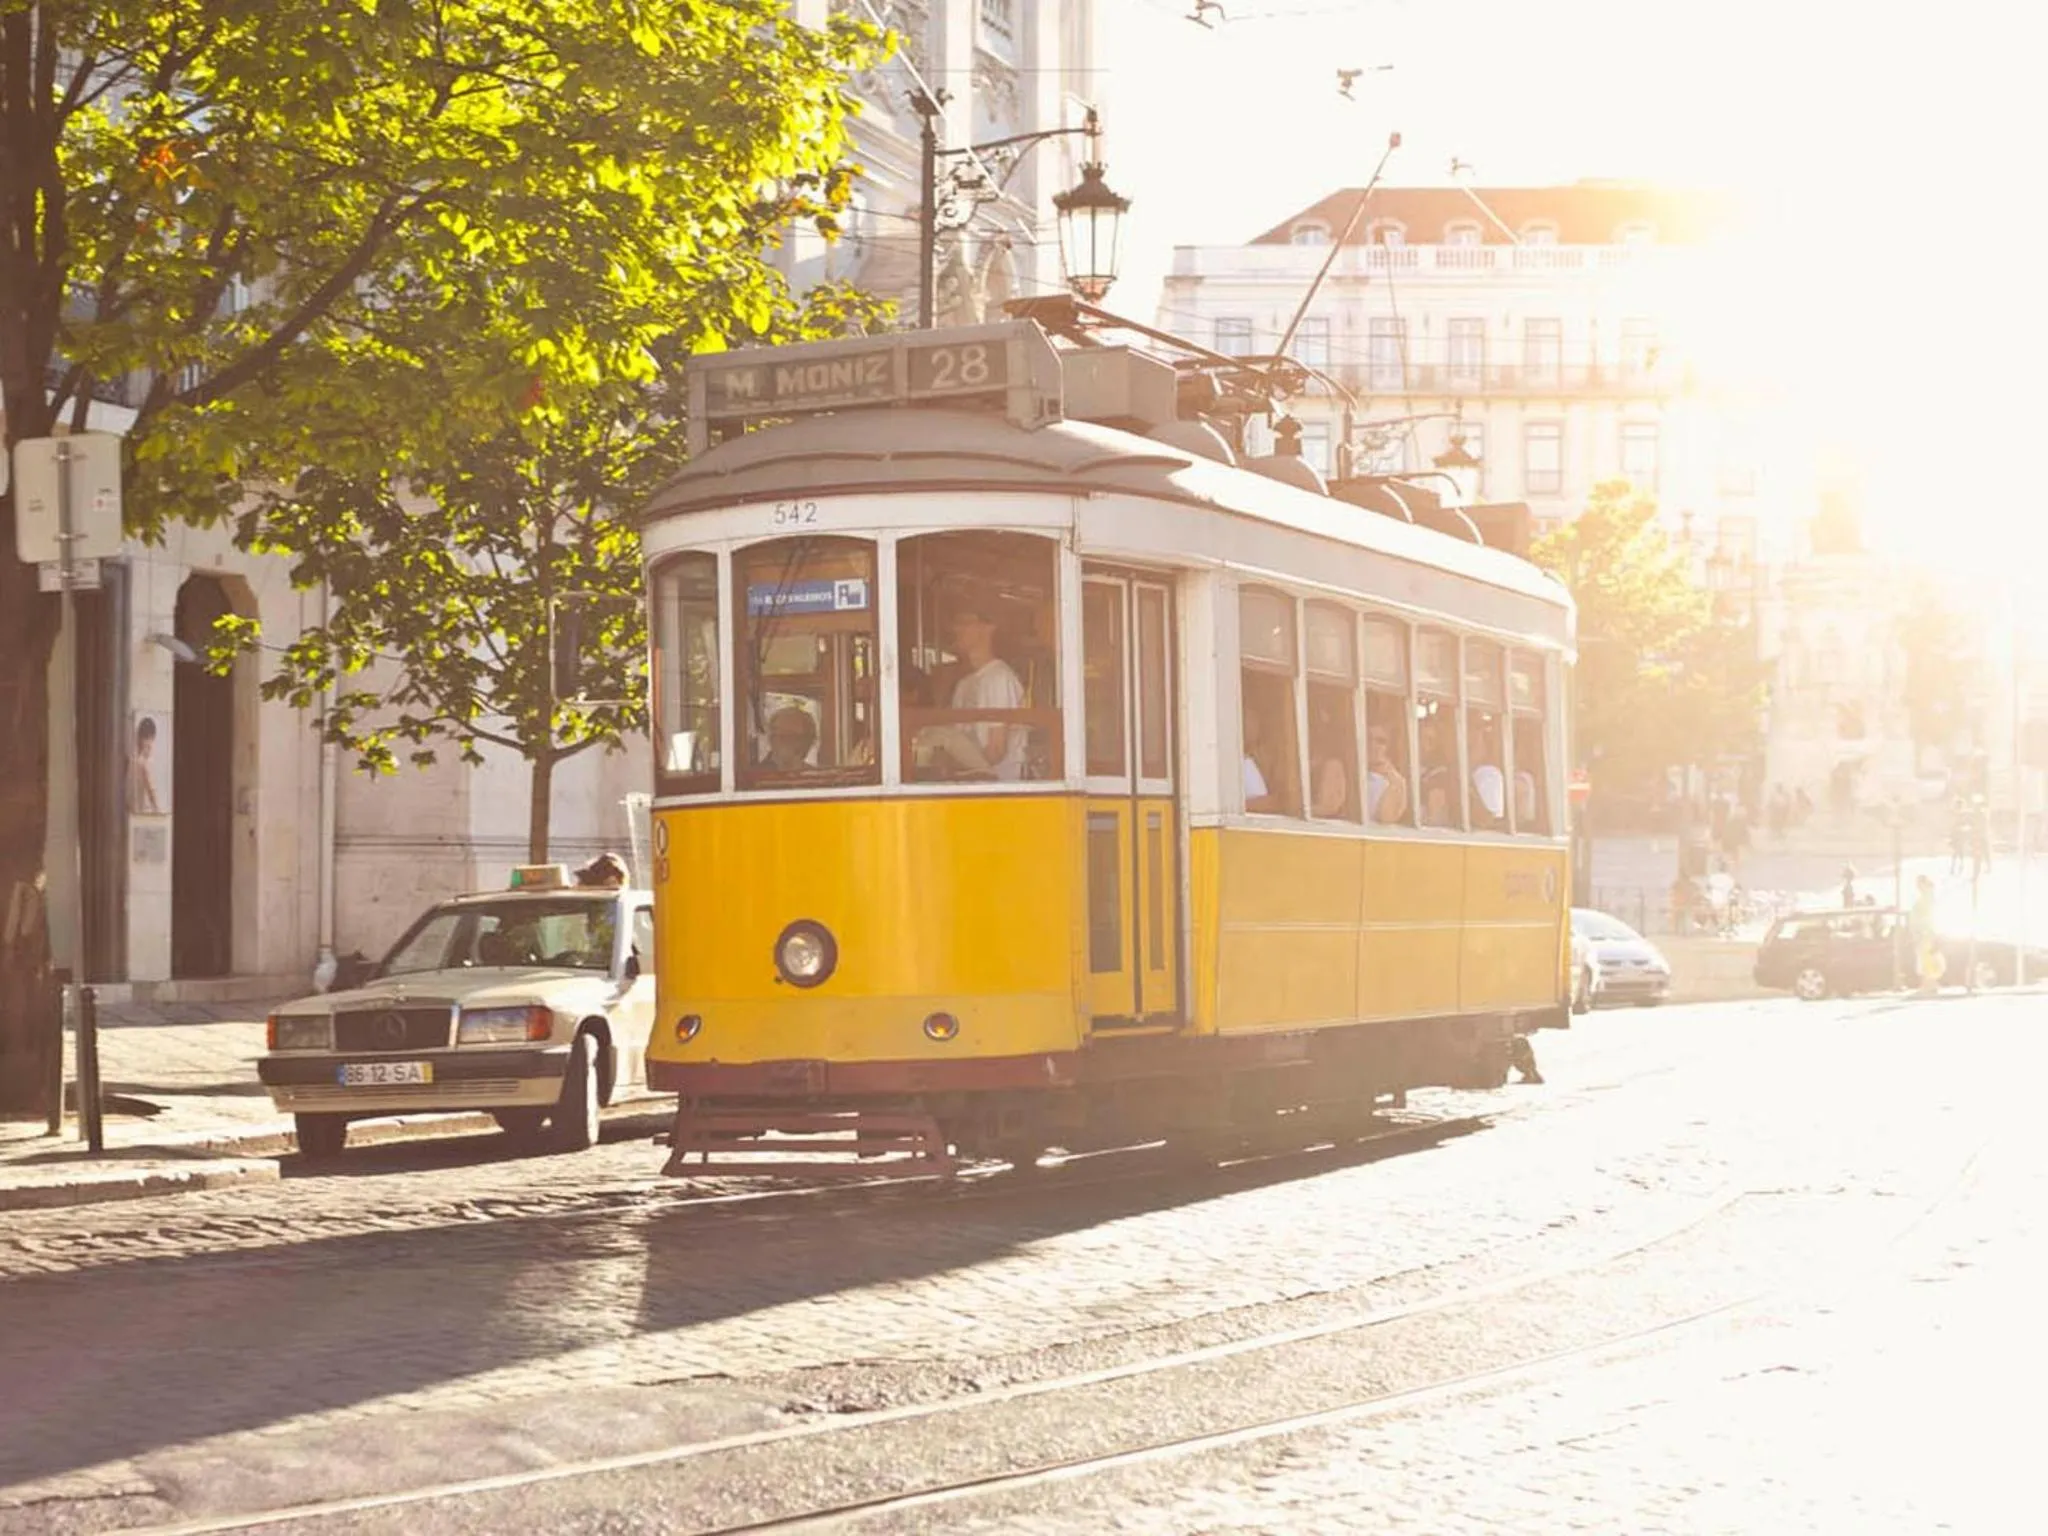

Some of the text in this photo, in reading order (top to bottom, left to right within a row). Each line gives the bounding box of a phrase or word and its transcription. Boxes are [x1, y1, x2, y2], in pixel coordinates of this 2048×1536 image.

[775, 355, 888, 396] MONIZ
[930, 344, 989, 389] 28
[774, 501, 818, 525] 542
